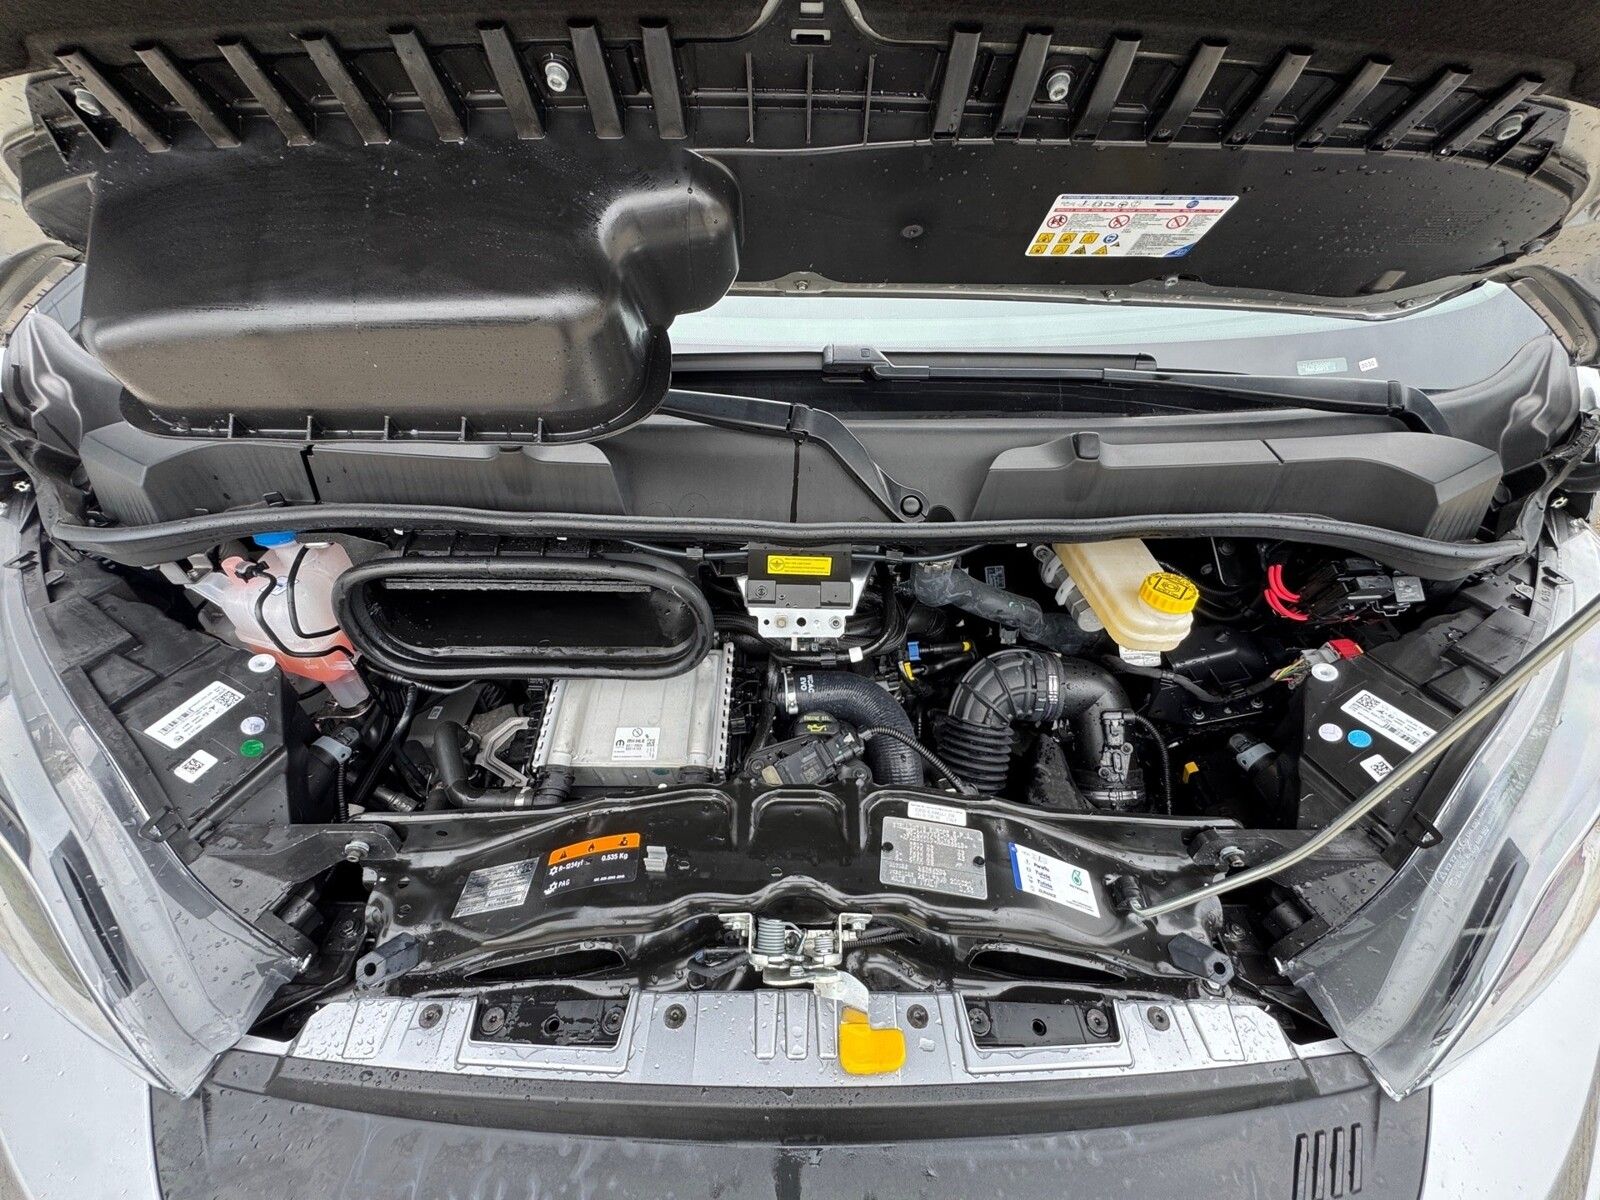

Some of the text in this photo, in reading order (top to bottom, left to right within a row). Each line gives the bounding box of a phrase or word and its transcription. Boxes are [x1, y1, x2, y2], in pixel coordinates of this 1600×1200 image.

[601, 852, 629, 861] 0.535 Kg
[558, 879, 571, 888] PAG
